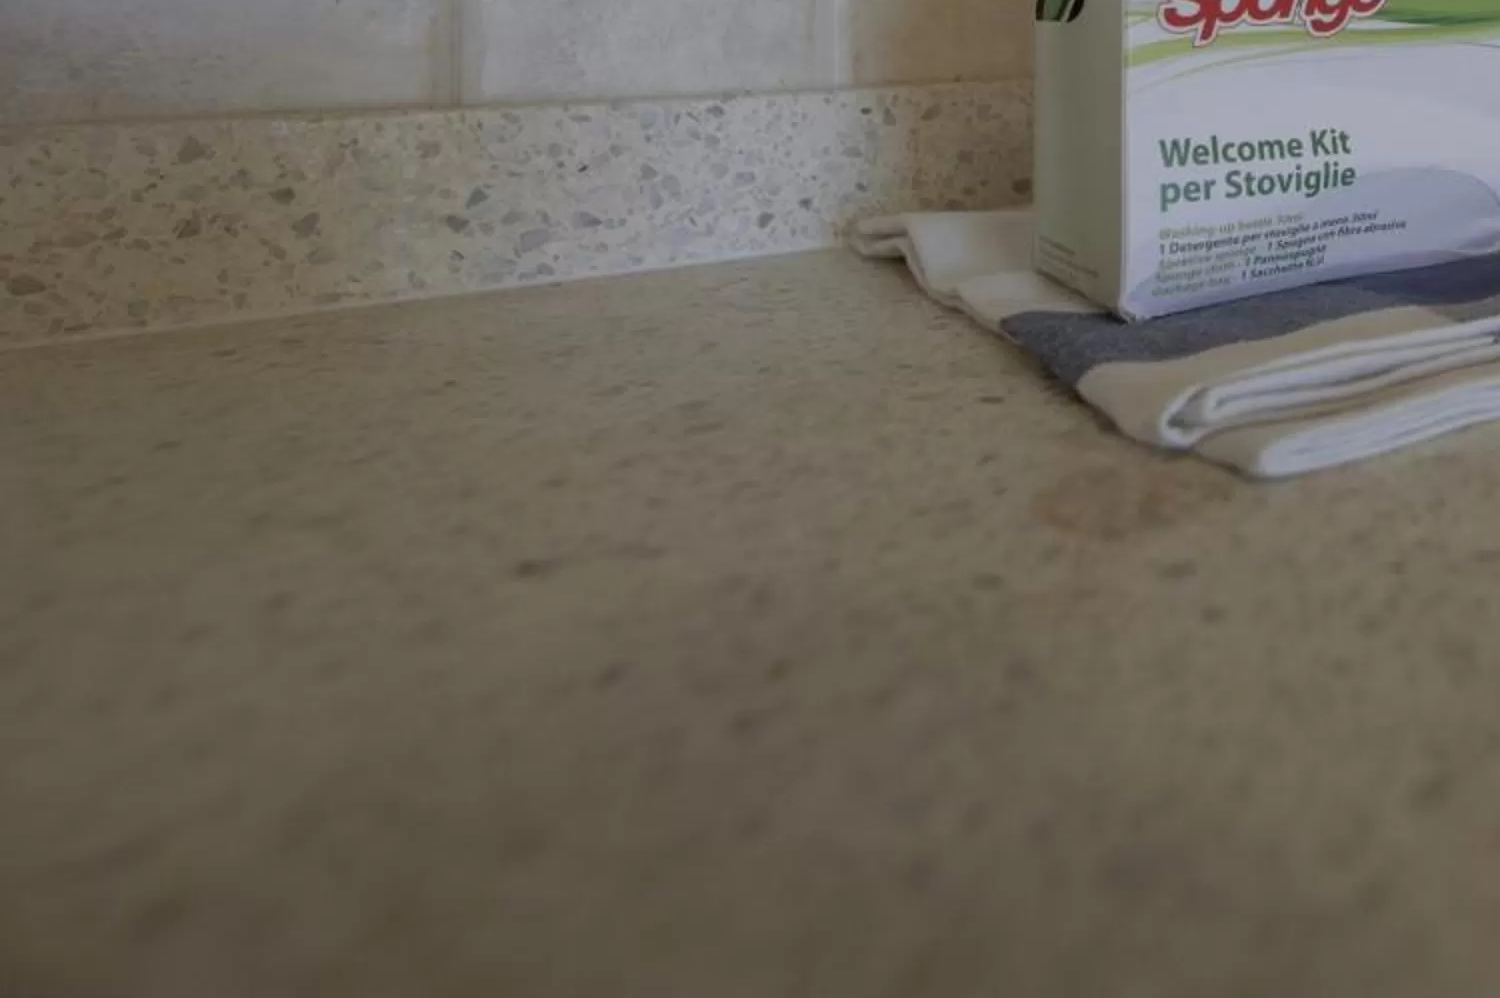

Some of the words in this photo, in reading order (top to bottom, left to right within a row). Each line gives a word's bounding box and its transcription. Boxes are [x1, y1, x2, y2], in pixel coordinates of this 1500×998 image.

[1159, 134, 1303, 168] Welcome
[1309, 128, 1352, 157] Kit
[1160, 178, 1216, 212] per
[1225, 162, 1356, 199] Stoviglie
